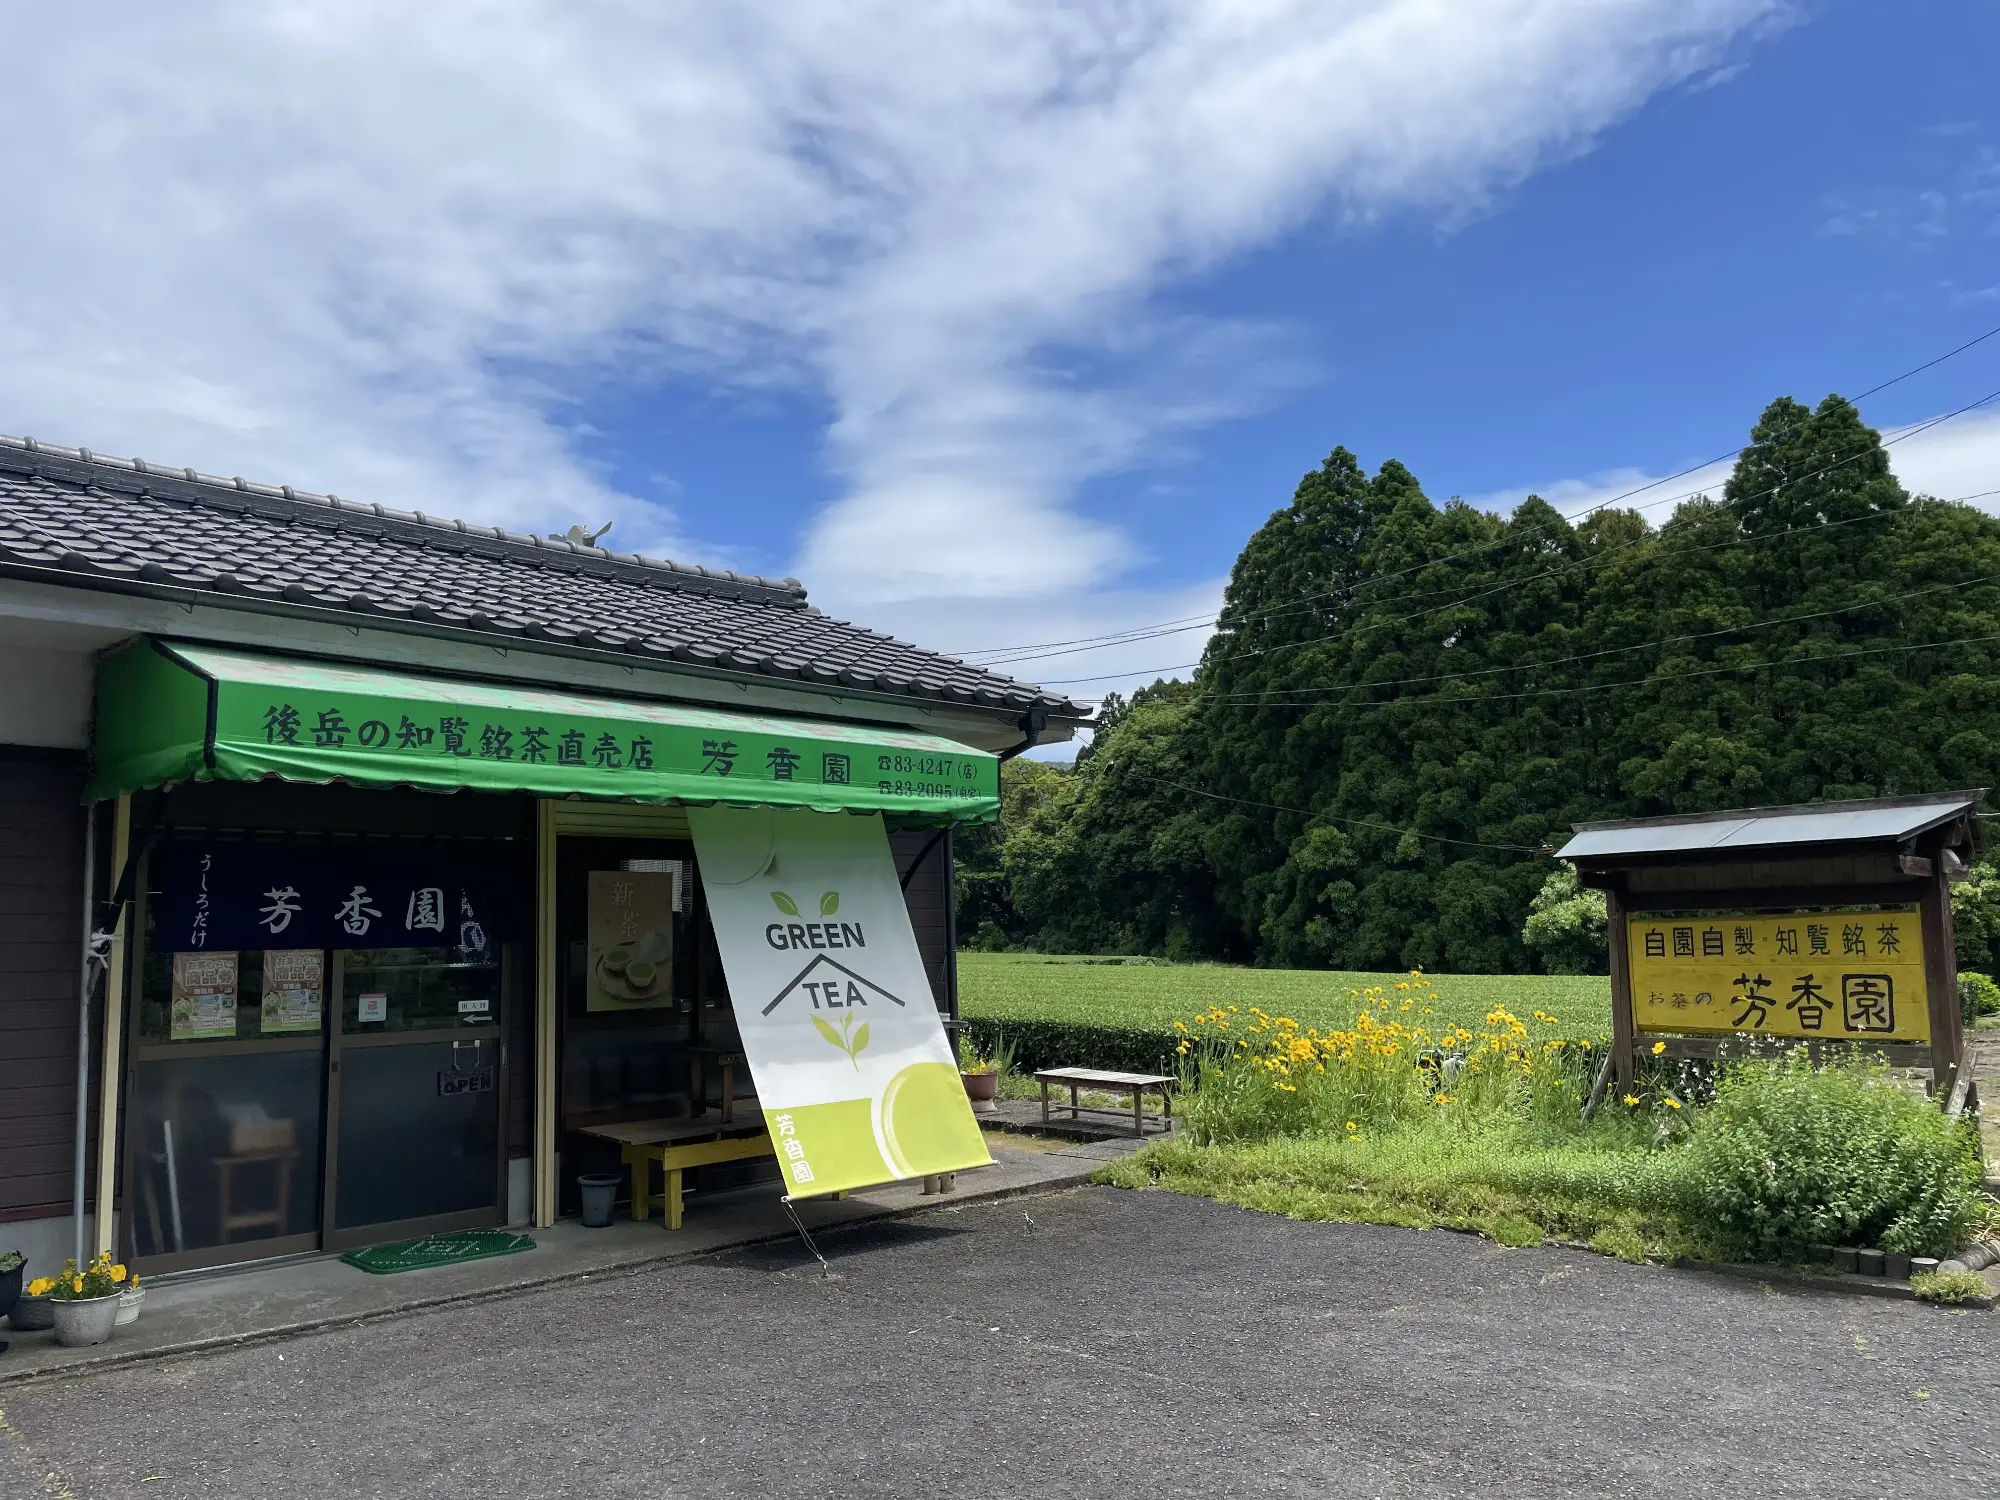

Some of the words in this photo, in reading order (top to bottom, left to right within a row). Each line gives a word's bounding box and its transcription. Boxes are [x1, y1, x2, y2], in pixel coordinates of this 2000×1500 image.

[261, 704, 655, 771] 後岳の知覧銘茶直売店
[700, 740, 851, 786] 芳香園
[190, 853, 213, 949] うしろだけ
[258, 884, 446, 936] 芳香園
[611, 880, 641, 938] 新茶
[765, 922, 867, 951] GREEN
[185, 969, 235, 986] 商品券
[274, 966, 321, 981] 商品券
[802, 980, 868, 1010] TEA
[1648, 990, 1713, 1010] お茶の
[1730, 972, 1896, 1033] 芳香園
[443, 1075, 492, 1094] OPEN
